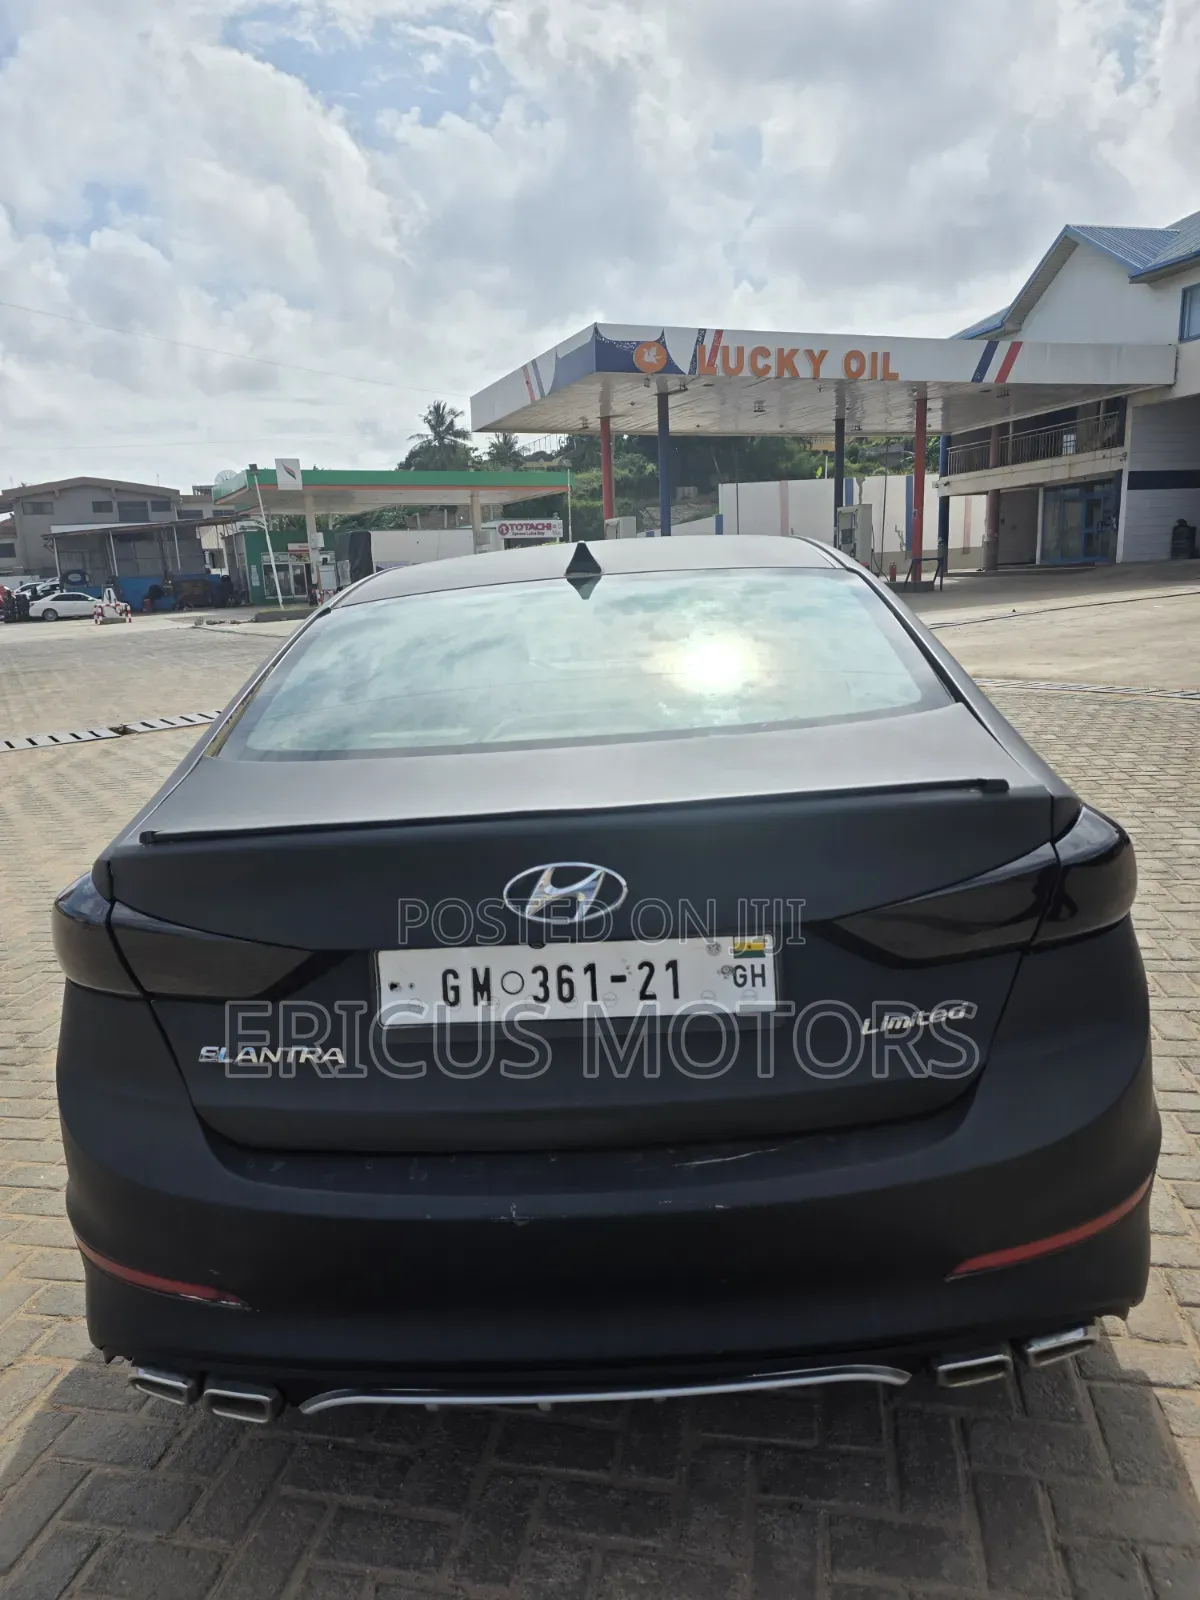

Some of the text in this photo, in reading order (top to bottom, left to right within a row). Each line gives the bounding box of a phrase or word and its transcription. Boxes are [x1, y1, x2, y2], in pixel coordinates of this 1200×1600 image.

[697, 344, 899, 381] LUCKY OIL
[508, 522, 552, 531] TOTACHI
[441, 960, 680, 1007] GM 361-21
[733, 964, 766, 988] GH
[861, 1001, 968, 1035] Limited
[198, 1045, 345, 1064] ELANTRA
